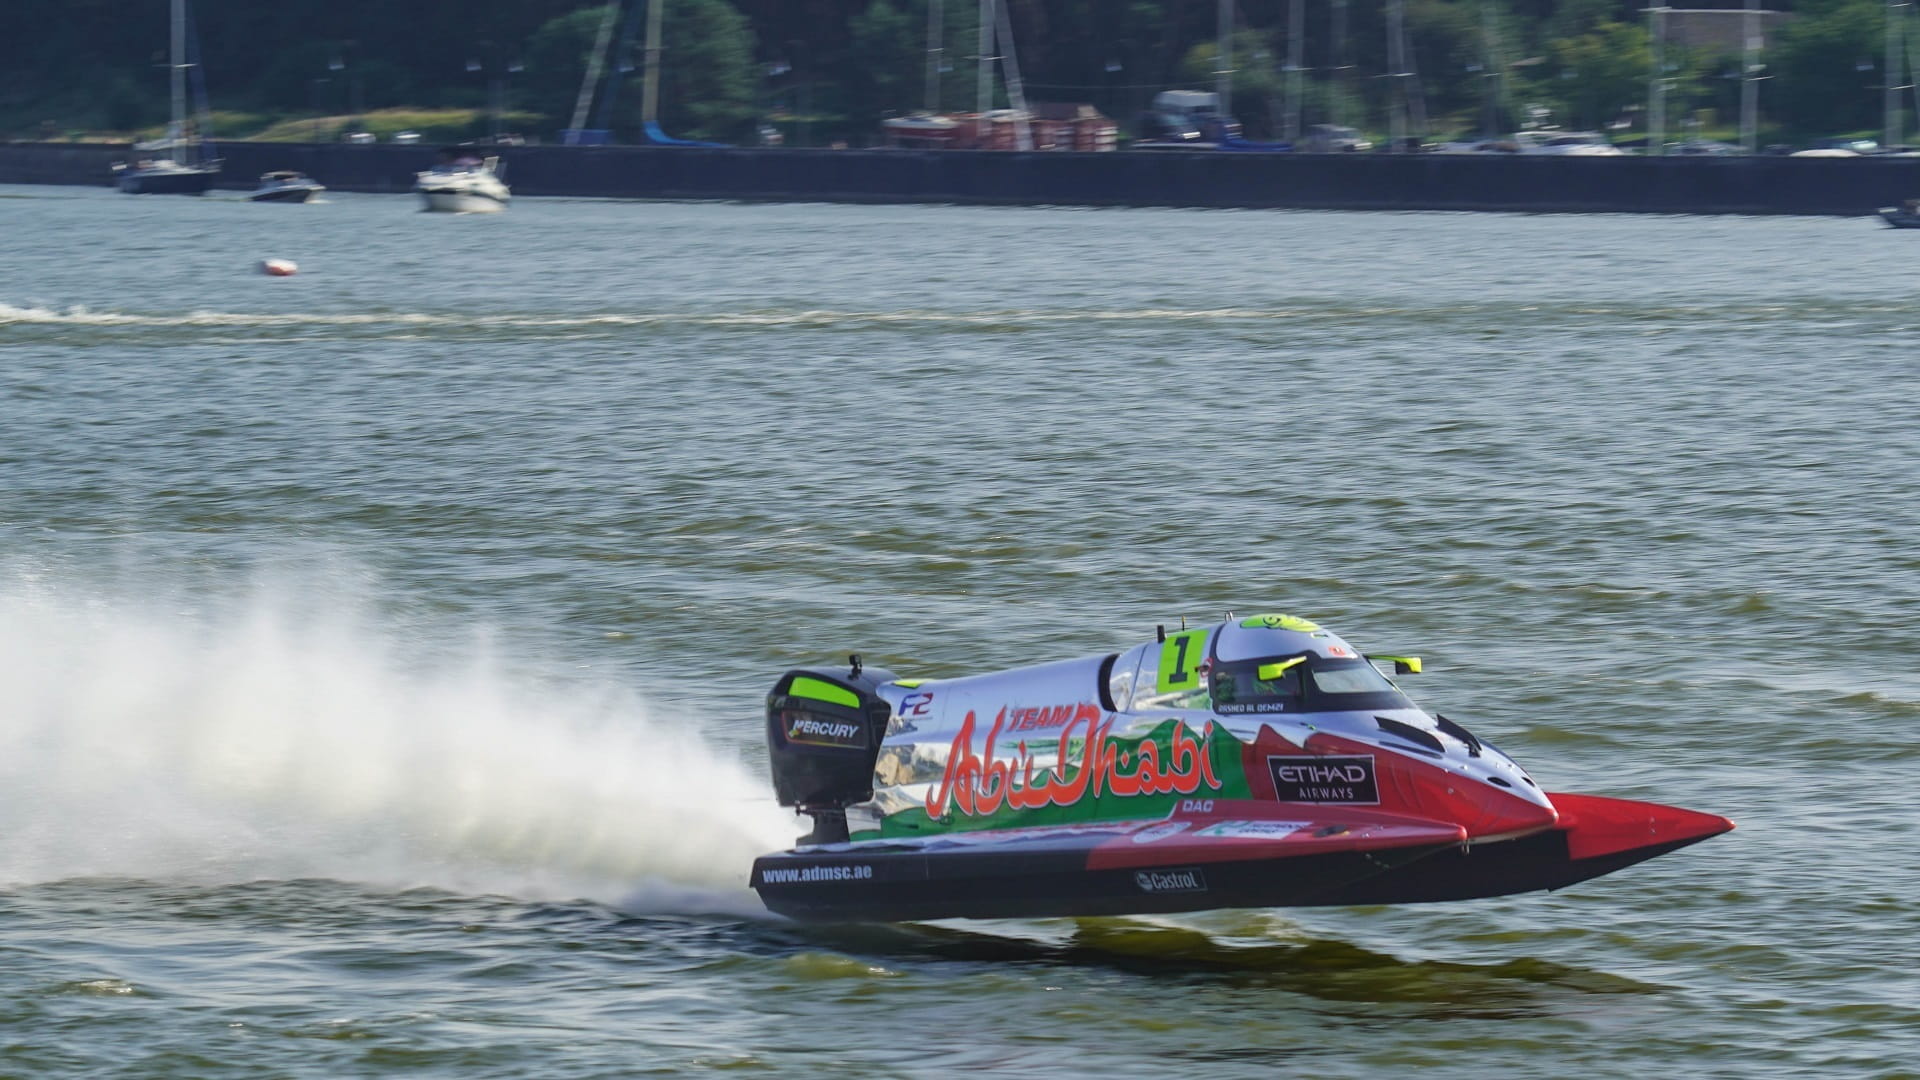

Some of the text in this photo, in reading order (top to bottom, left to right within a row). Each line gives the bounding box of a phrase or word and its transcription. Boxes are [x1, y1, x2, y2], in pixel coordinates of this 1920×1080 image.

[1169, 636, 1190, 684] 1
[898, 692, 934, 716] F2
[1006, 703, 1072, 732] TEAM
[792, 719, 860, 739] MERCURY
[925, 701, 1223, 821] Abu Dhabi
[1278, 765, 1366, 783] ETIHAD
[1299, 786, 1354, 800] AIRWAYS
[1181, 800, 1215, 813] DAC
[762, 865, 873, 884] www.admsc.ae
[1150, 871, 1199, 890] Castrol
